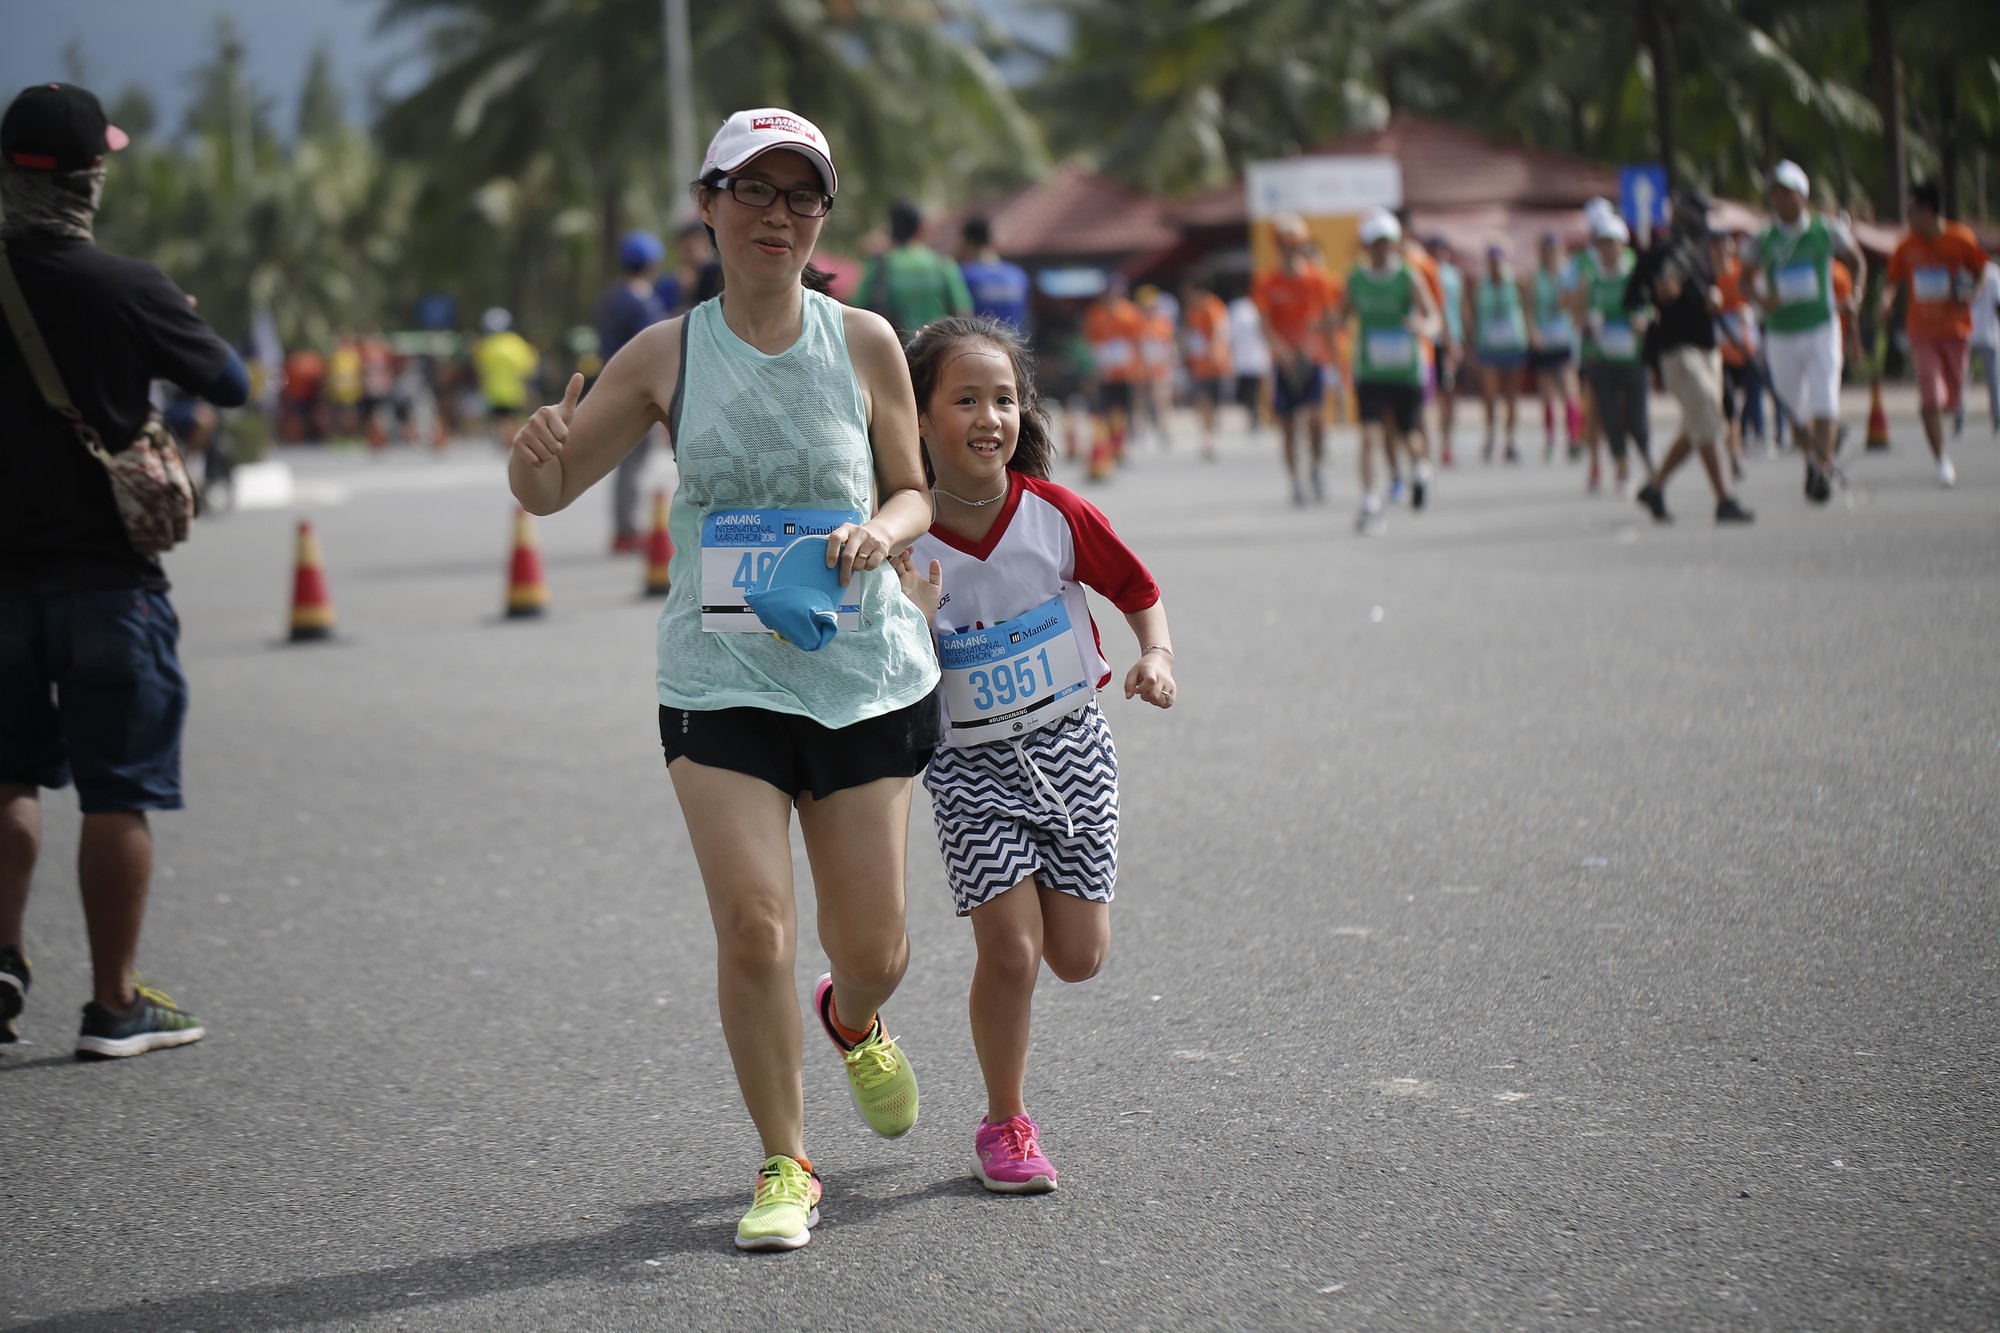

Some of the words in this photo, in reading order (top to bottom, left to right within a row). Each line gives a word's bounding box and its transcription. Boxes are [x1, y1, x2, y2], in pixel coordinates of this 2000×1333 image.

[716, 514, 761, 525] DANANG
[715, 525, 775, 533] INTERNATIONAL
[714, 533, 761, 542] MARATHON
[761, 533, 777, 542] 2018
[1022, 616, 1058, 640] Manulife
[943, 634, 988, 649] DANANG
[945, 640, 1002, 657] INTERNATIONAL
[946, 652, 992, 664] MARATHON
[990, 646, 1006, 658] 2018
[968, 647, 1053, 711] 3951
[988, 708, 1028, 723] #RUNDANANG
